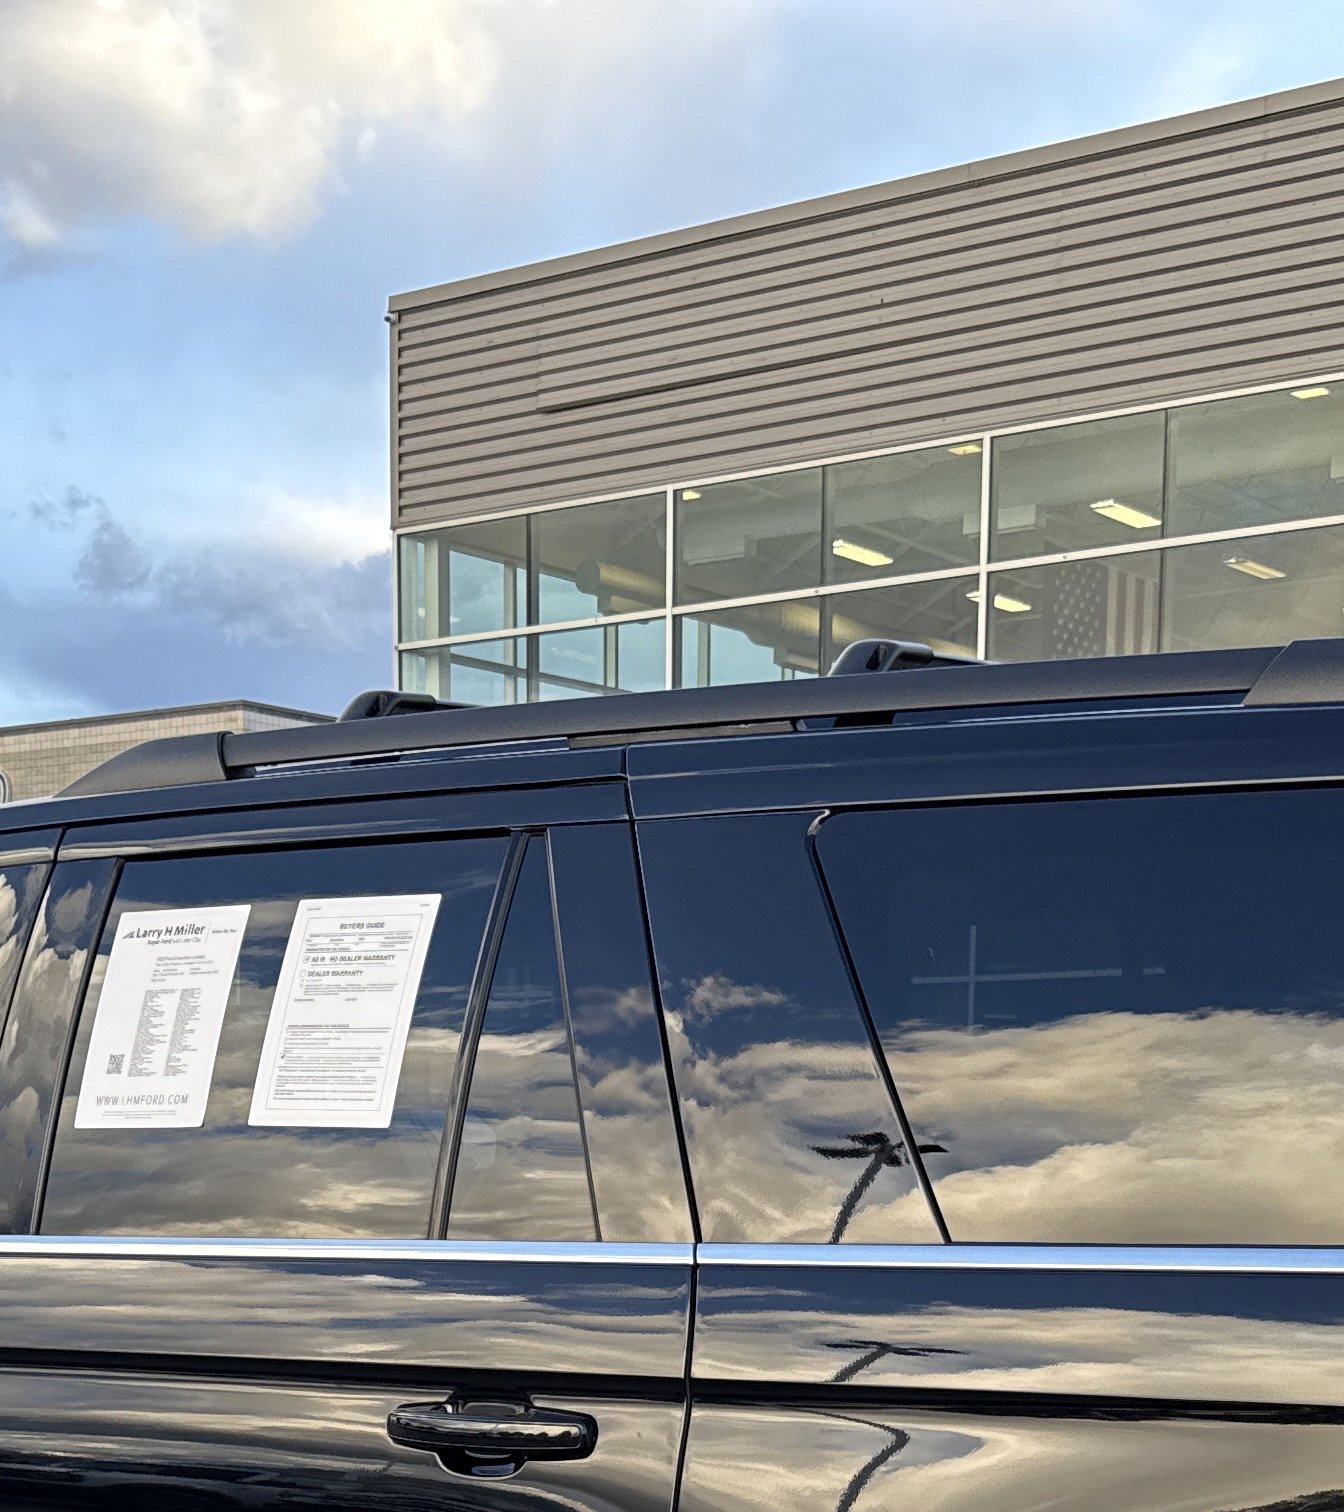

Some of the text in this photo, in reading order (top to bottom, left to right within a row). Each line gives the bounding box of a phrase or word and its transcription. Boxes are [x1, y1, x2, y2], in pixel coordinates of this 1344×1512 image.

[135, 928, 164, 939] Larry
[164, 926, 173, 936] H
[174, 923, 206, 936] Miller
